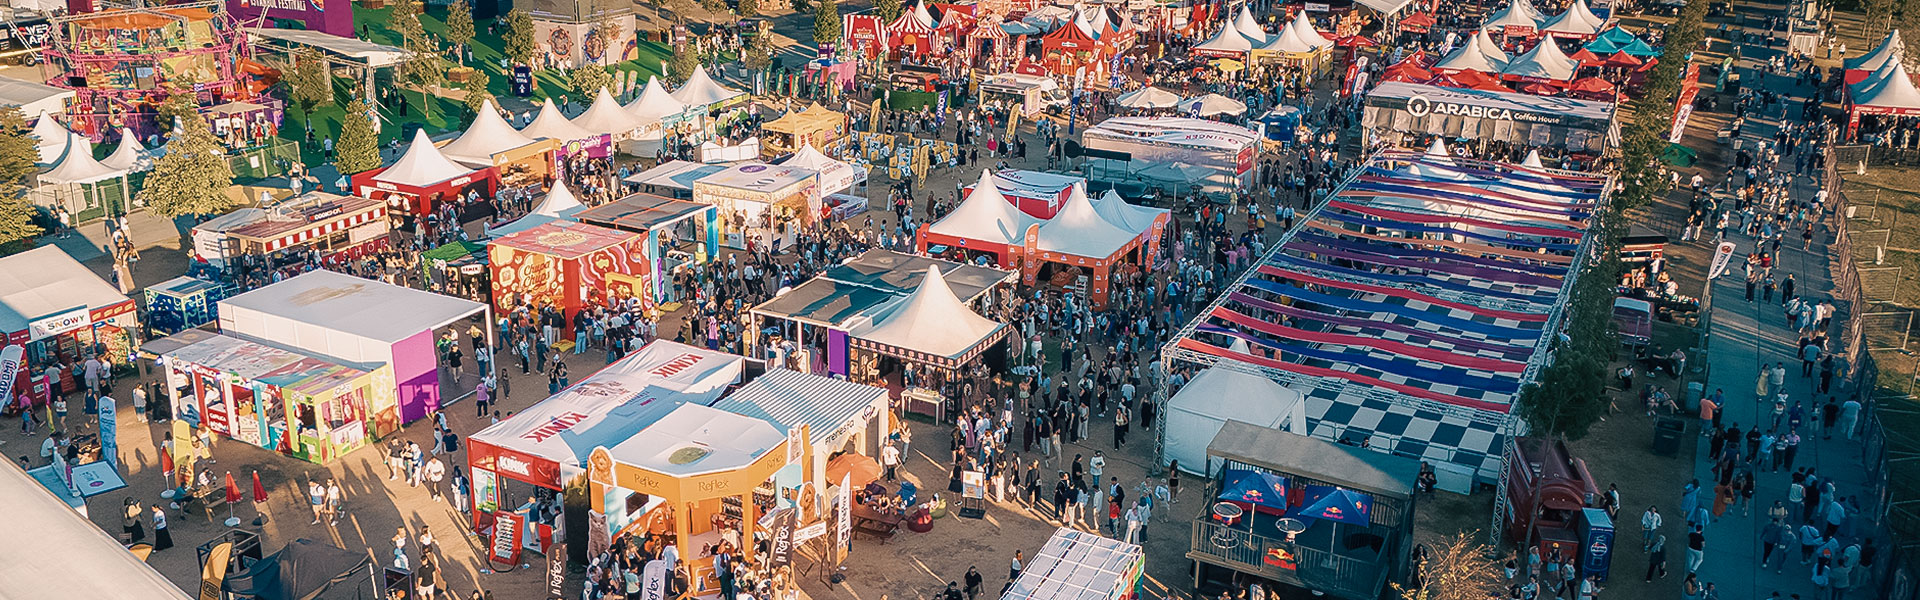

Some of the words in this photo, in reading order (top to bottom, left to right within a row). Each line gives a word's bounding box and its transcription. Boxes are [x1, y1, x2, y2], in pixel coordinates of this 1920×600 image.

[1433, 103, 1513, 121] ARABICA
[1513, 112, 1538, 122] Coffee
[1538, 115, 1560, 124] House
[1185, 134, 1225, 142] SINGER
[523, 261, 551, 276] Chupa
[523, 272, 550, 289] Chups
[47, 315, 85, 330] SNOWY
[652, 353, 704, 378] KINIK
[524, 412, 588, 443] KINIK
[498, 455, 530, 476] KINIK
[634, 473, 660, 489] Reflex
[698, 479, 729, 492] Reflex
[775, 525, 790, 555] Reflex
[551, 560, 564, 588] Reflex
[646, 578, 660, 600] eflex
